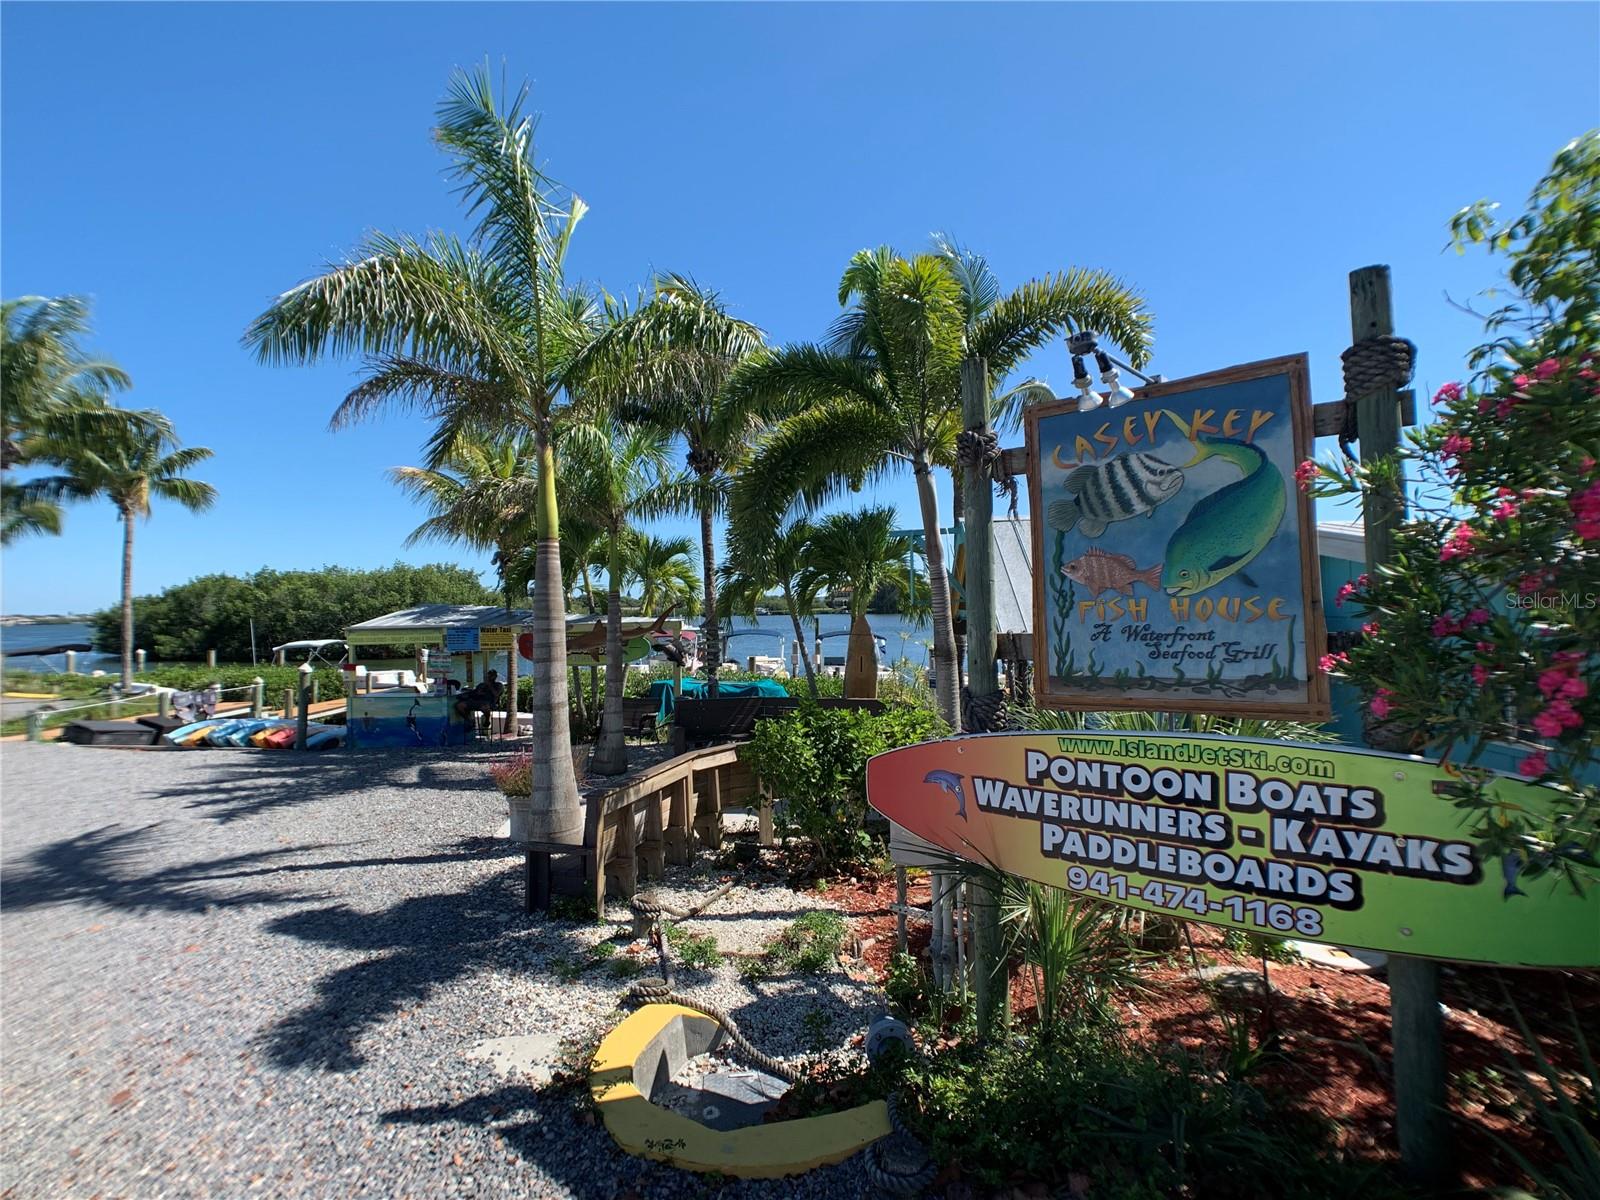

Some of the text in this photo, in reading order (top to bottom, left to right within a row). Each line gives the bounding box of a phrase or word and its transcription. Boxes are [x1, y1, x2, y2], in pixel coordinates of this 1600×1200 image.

[1053, 408, 1275, 469] CASEY KEY
[1090, 623, 1216, 648] A Waterfront
[1169, 596, 1290, 623] HOUSE
[1145, 641, 1278, 666] Seafood Grill
[1026, 750, 1380, 821] PONTOON BOATS
[1057, 736, 1335, 779] www.IslandJetSki.com
[973, 778, 1229, 845] WAVERUNNERS
[1272, 816, 1477, 879] KAYAKS
[1042, 823, 1358, 905] PADDLEBOARDS
[1067, 866, 1324, 937] 941-474-1168
